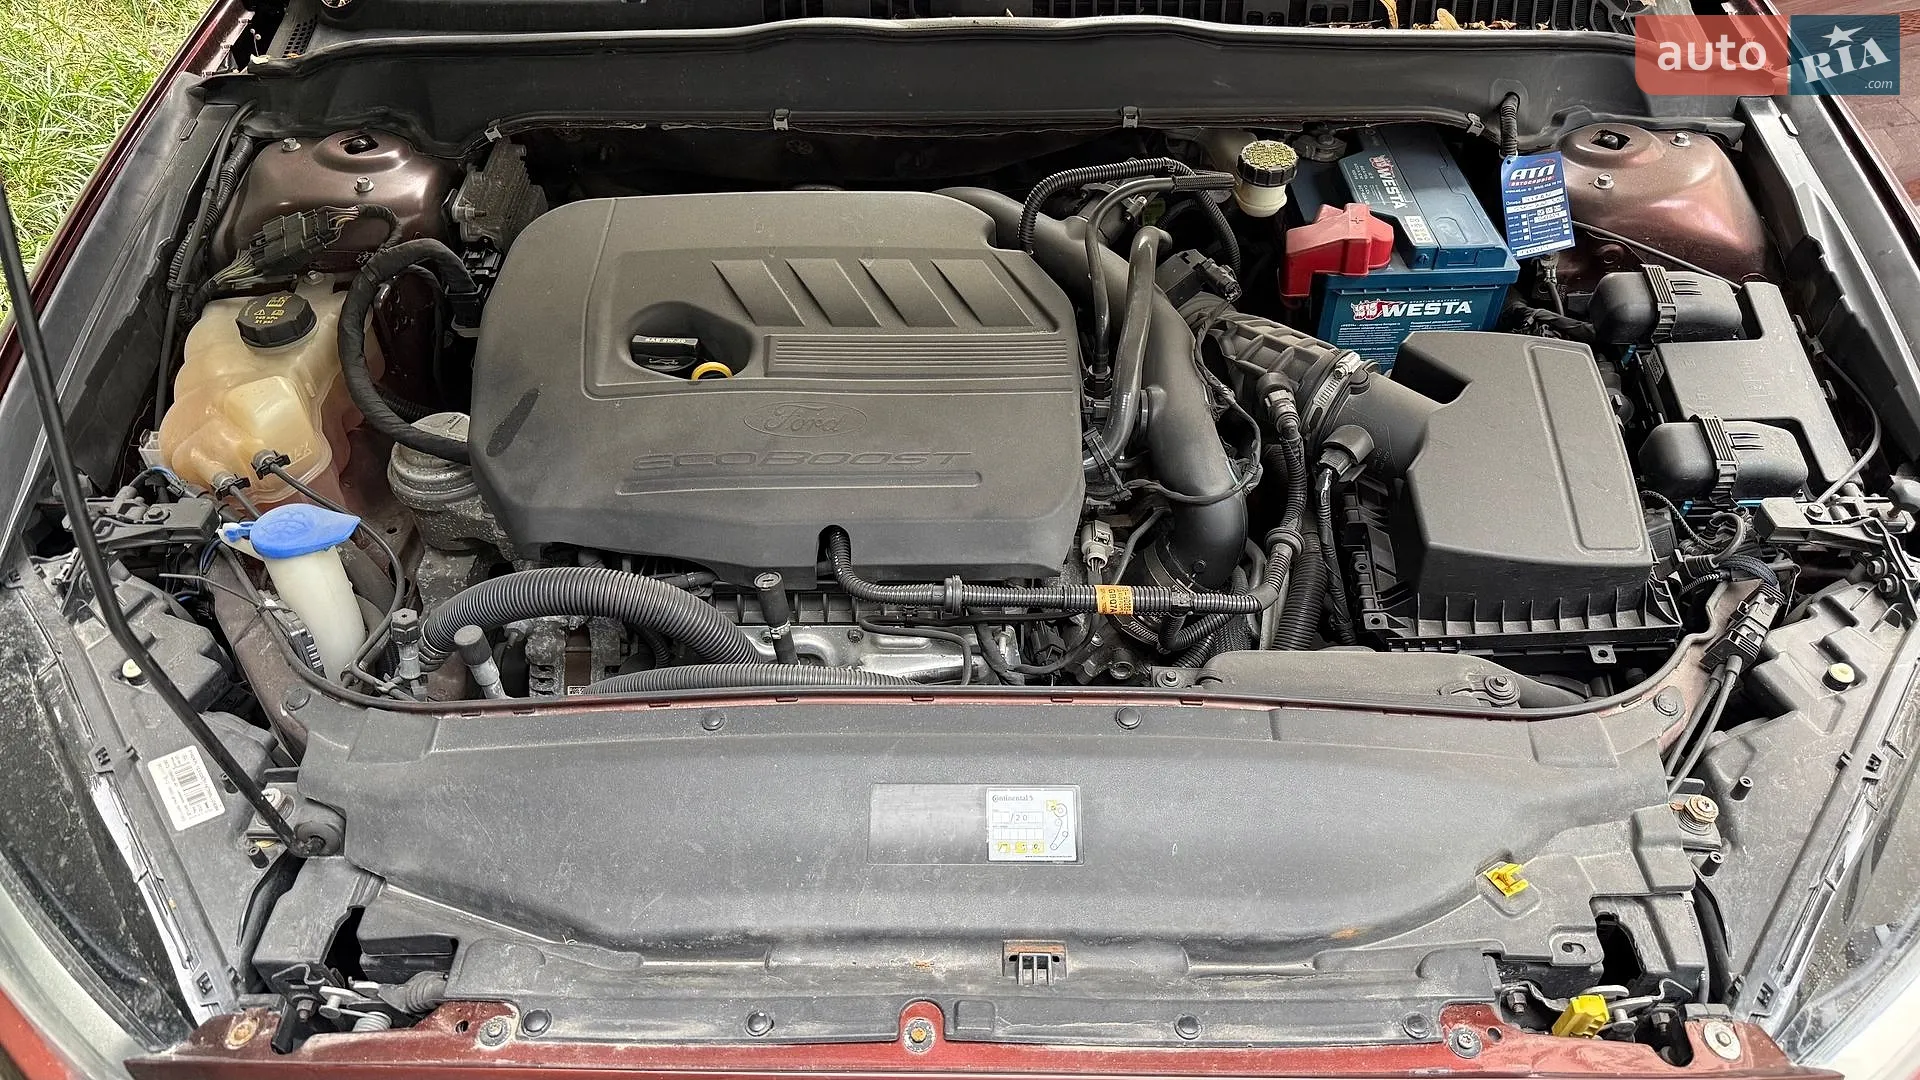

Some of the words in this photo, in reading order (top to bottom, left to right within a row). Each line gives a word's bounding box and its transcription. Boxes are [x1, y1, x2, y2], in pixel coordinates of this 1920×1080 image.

[1376, 168, 1407, 210] WESTA
[1382, 301, 1472, 318] WESTA
[764, 404, 843, 432] Ford
[633, 452, 973, 472] ECOBOOST
[991, 794, 1029, 803] Continental
